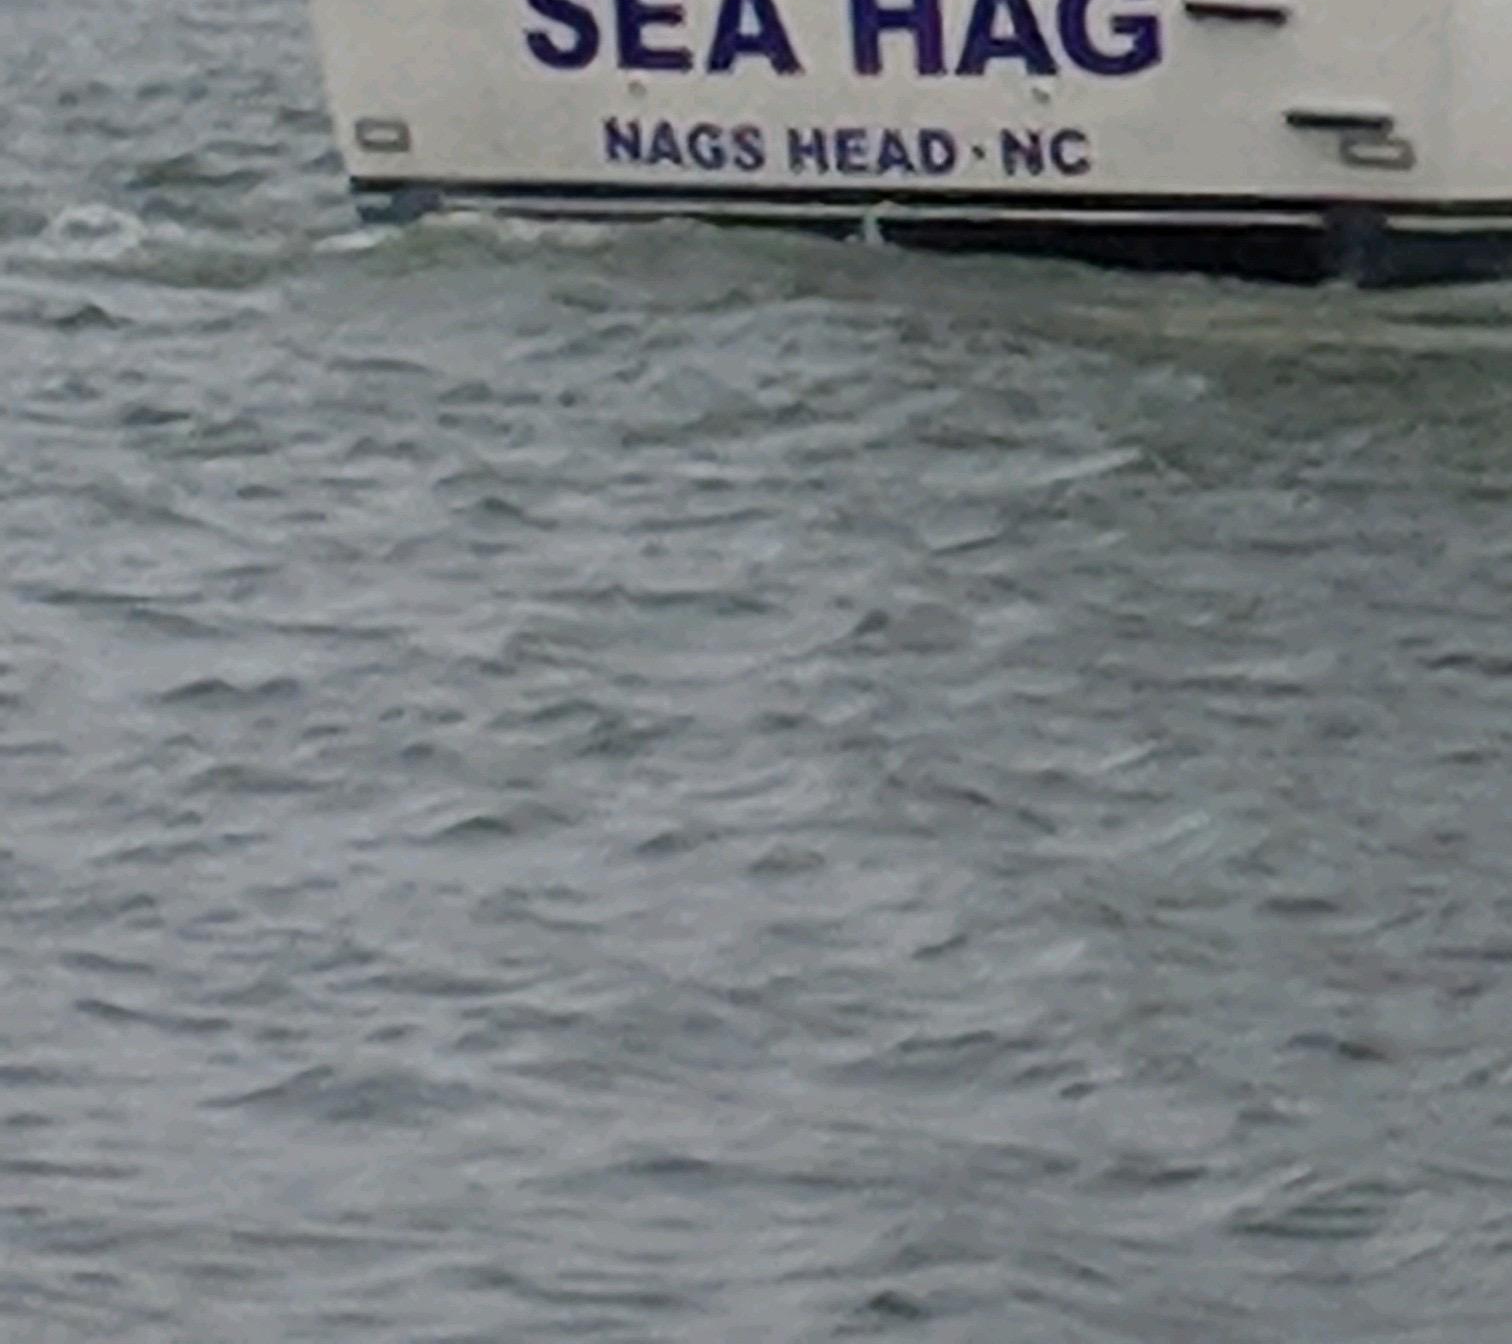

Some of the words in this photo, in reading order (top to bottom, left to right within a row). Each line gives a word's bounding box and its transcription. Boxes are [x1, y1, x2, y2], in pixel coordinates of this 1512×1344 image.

[602, 116, 766, 172] NAGS
[787, 127, 957, 175] HEAD
[1000, 127, 1093, 176] NC
